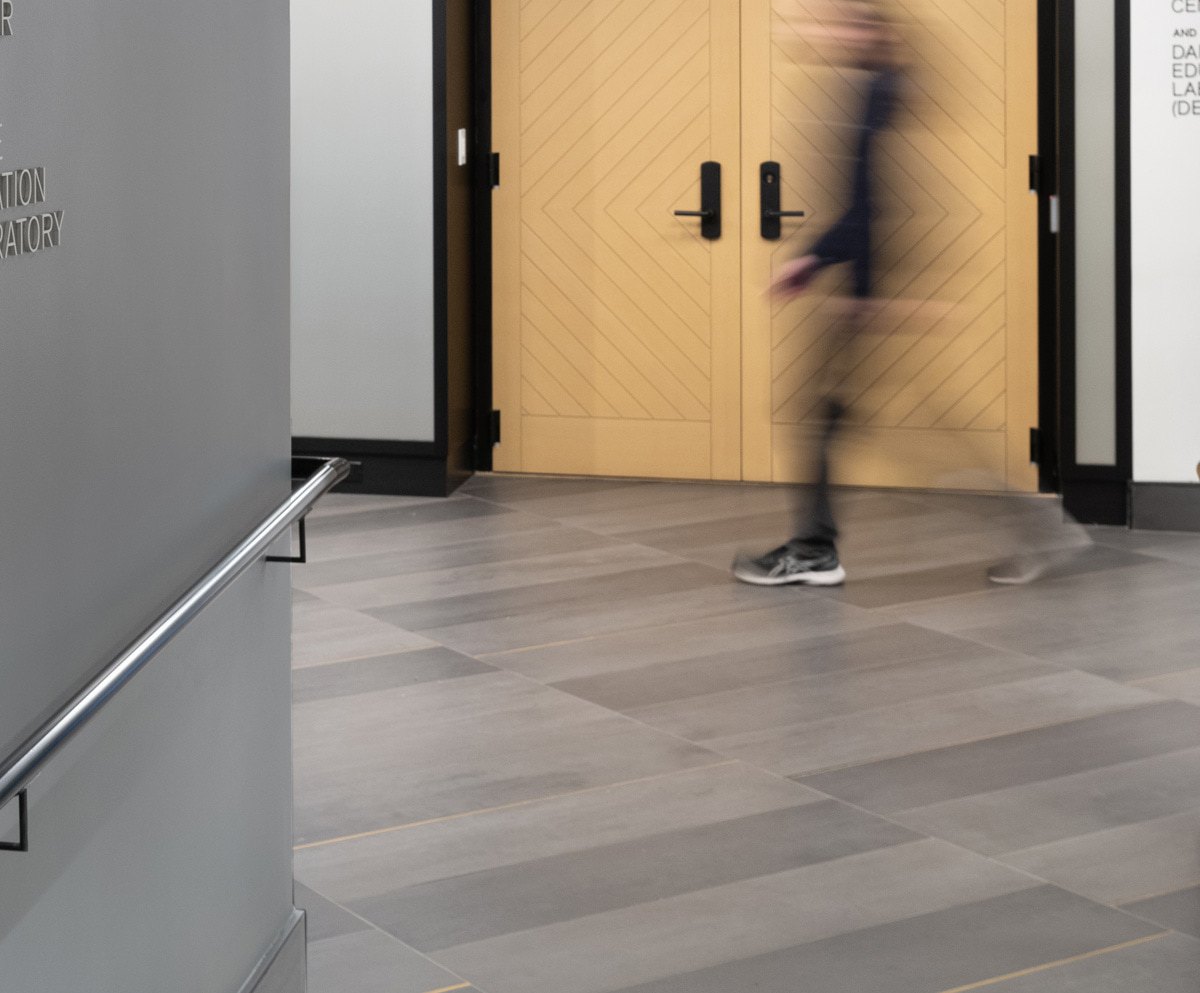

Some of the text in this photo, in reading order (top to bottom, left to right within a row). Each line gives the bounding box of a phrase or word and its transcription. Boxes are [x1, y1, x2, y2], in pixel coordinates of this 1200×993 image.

[1173, 28, 1197, 37] AND
[1172, 44, 1200, 59] DA
[1172, 63, 1200, 78] ED
[1172, 82, 1200, 97] LA
